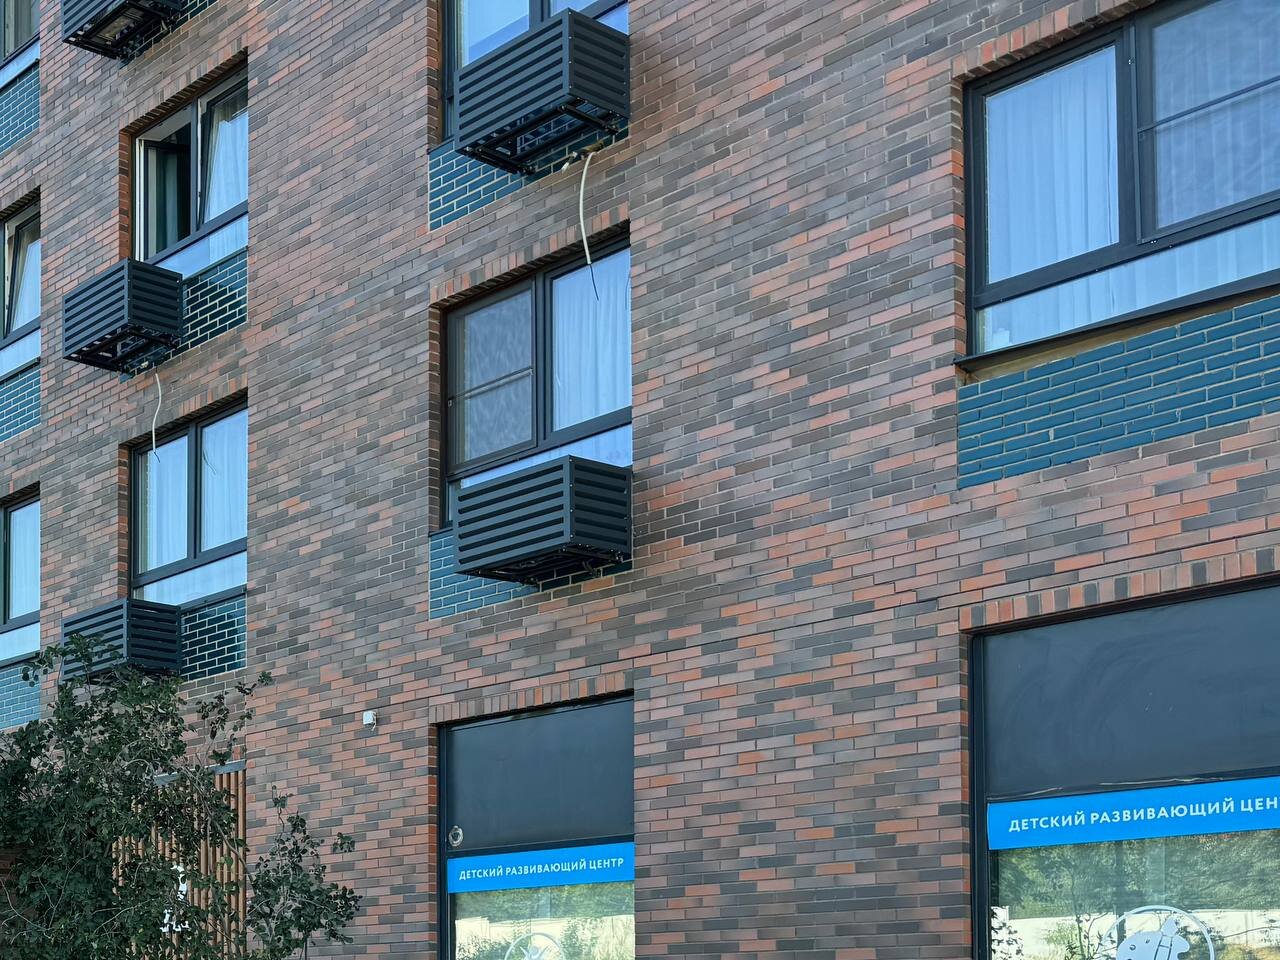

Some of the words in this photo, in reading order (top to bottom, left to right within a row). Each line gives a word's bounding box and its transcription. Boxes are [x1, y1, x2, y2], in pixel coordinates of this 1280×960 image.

[1008, 810, 1086, 833] ДЕТСКИЙ
[1090, 798, 1235, 825] РАЗВИВАЮЩИЙ
[1240, 796, 1280, 813] ЦЕН
[458, 865, 504, 881] ДЕТСКИЙ
[505, 858, 587, 876] РАЗВИВАЮЩИЙ
[589, 857, 624, 870] ЦЕНТР
